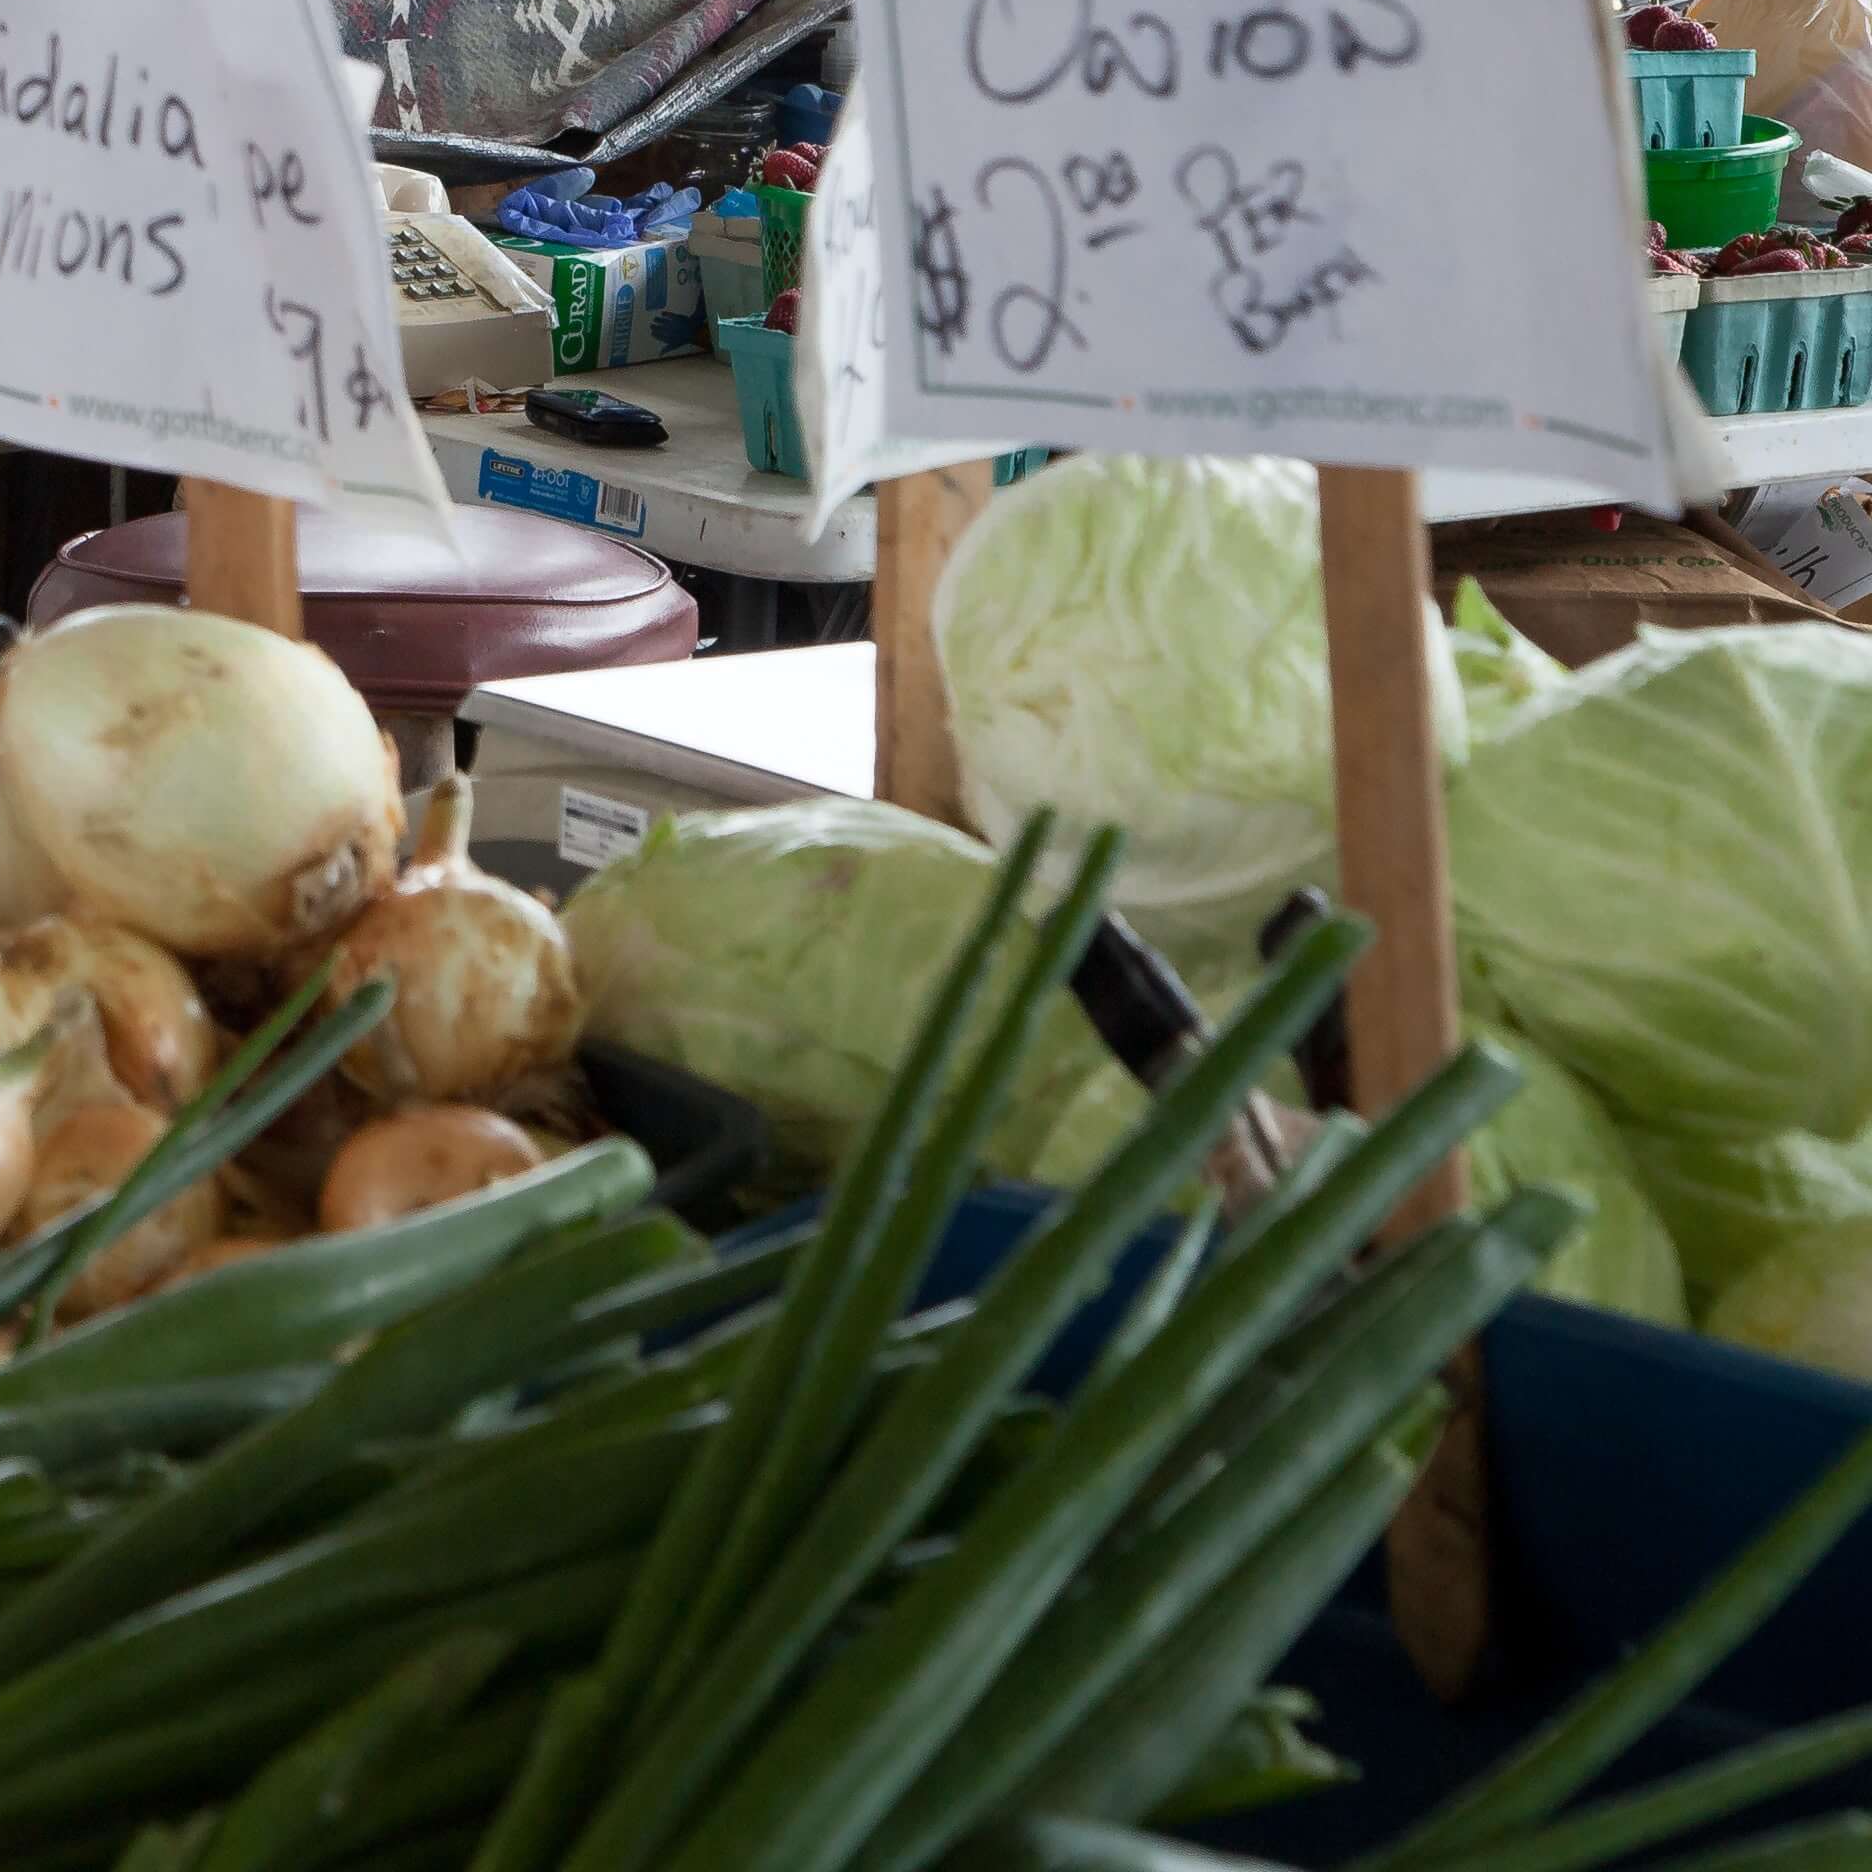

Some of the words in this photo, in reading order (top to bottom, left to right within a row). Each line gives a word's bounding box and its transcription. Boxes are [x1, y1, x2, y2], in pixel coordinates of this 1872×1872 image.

[559, 262, 589, 367] CURAD
[531, 467, 571, 488] 4-FOOT
[1827, 495, 1868, 550] PRODUCTS
[1581, 554, 1666, 568] Quart
